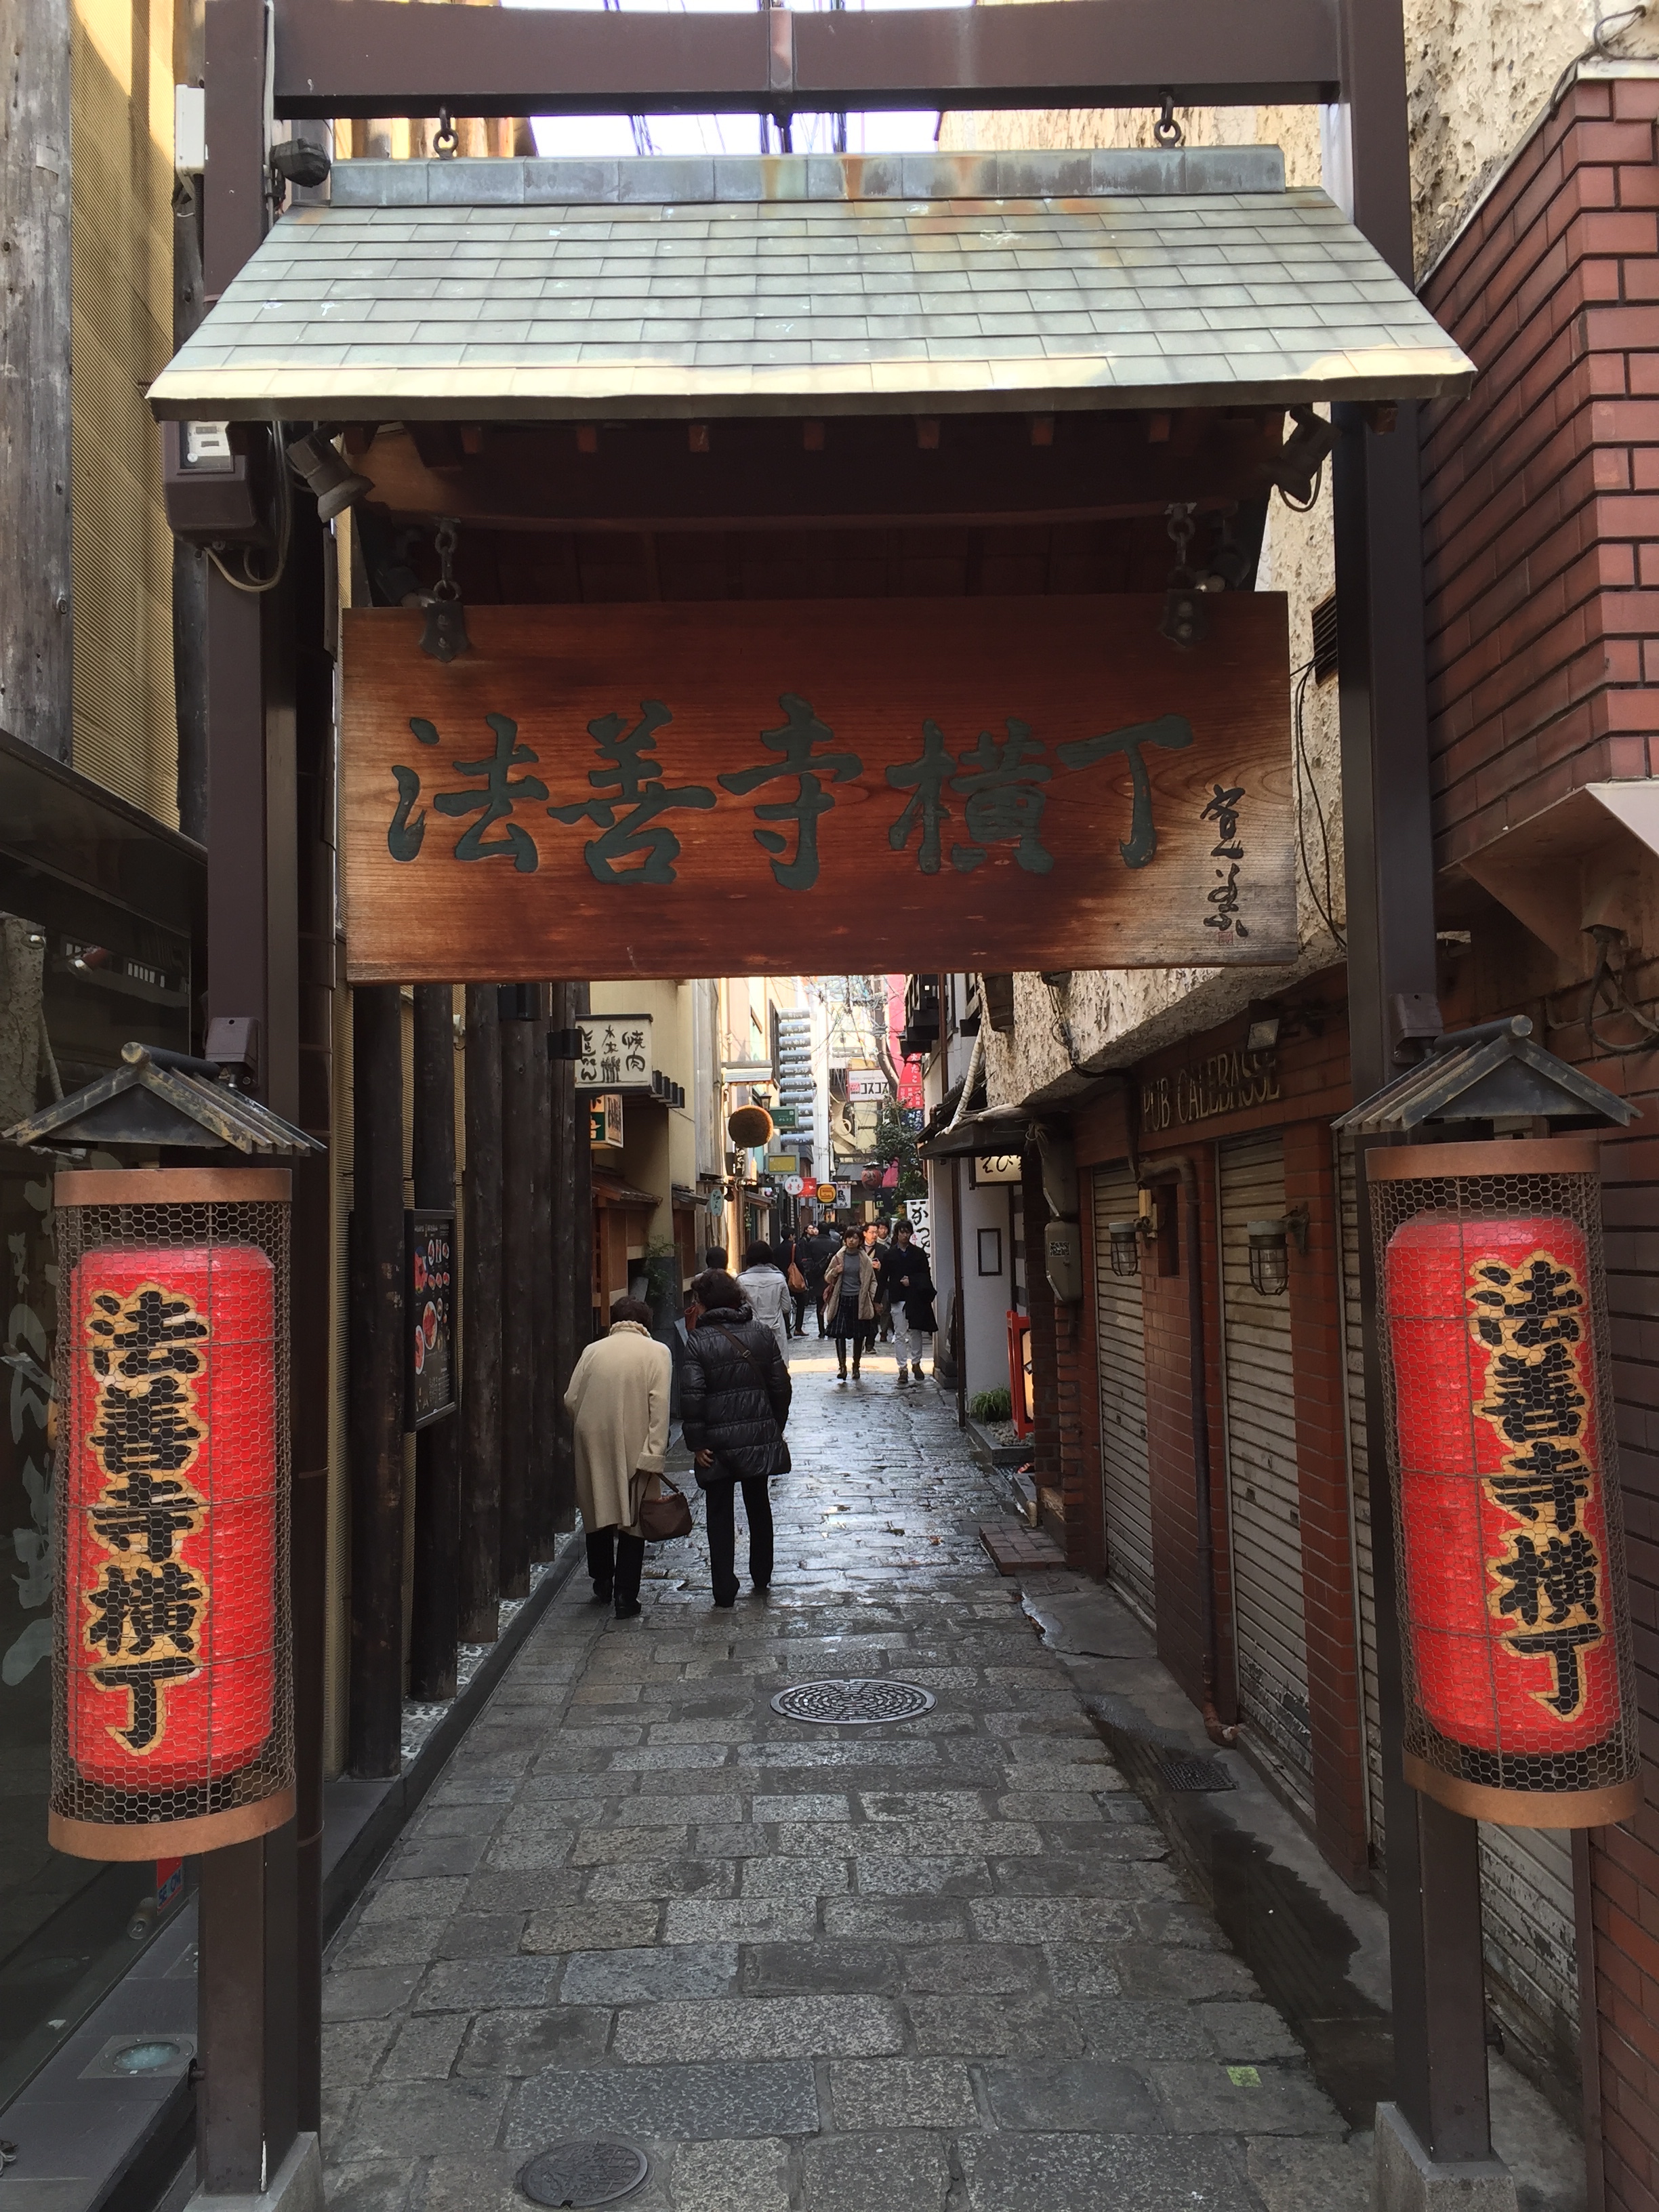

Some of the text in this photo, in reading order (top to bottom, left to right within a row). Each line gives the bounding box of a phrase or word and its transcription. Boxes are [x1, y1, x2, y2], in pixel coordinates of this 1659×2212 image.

[386, 693, 1195, 891] 法善寺横丁
[861, 1082, 889, 1096] コスコス
[1143, 1076, 1170, 1132] PUB
[85, 1287, 210, 1753] 法善寺横丁
[1469, 1258, 1603, 1718] 法善寺横丁
